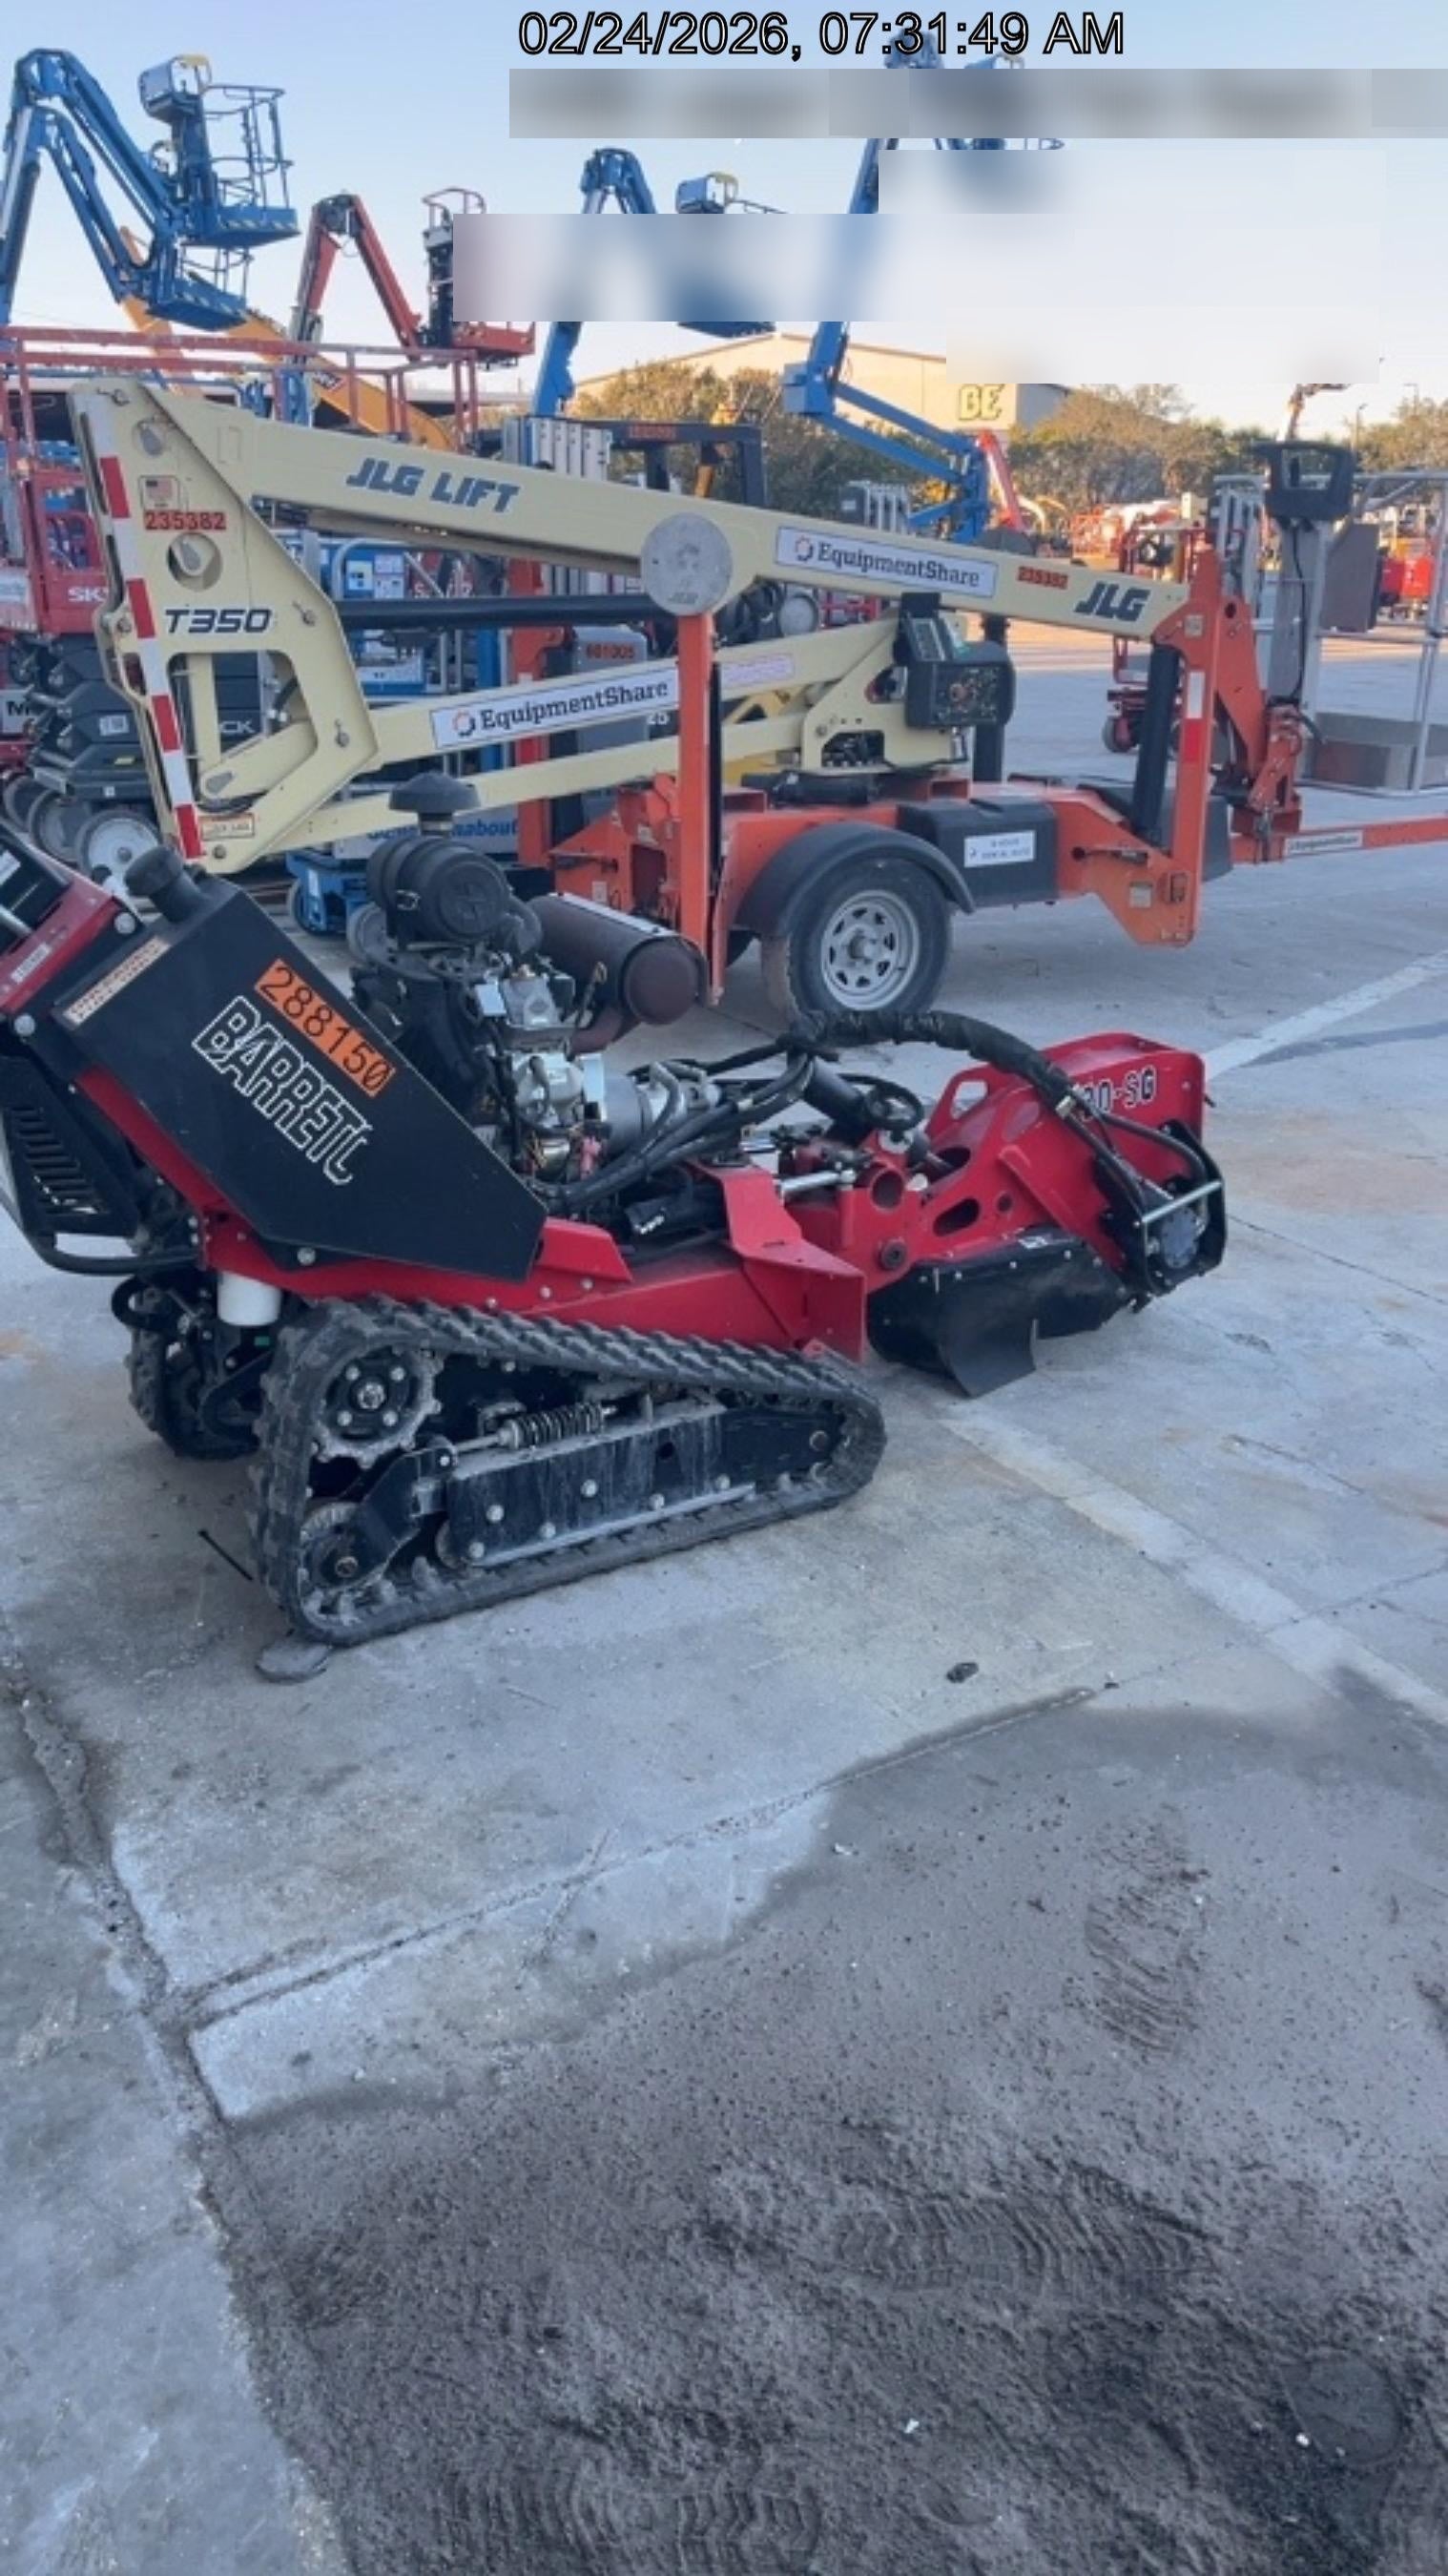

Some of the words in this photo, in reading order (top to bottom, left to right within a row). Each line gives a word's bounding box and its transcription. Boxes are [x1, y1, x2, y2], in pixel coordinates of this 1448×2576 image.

[346, 458, 424, 496] JLG
[431, 471, 521, 512] LIFT
[144, 510, 227, 530] 235382
[817, 541, 981, 588] EquipmentShare
[165, 609, 273, 634] T350
[1074, 580, 1151, 622] JLG
[480, 681, 669, 731] EquipmentShare
[259, 966, 391, 1091] 288150
